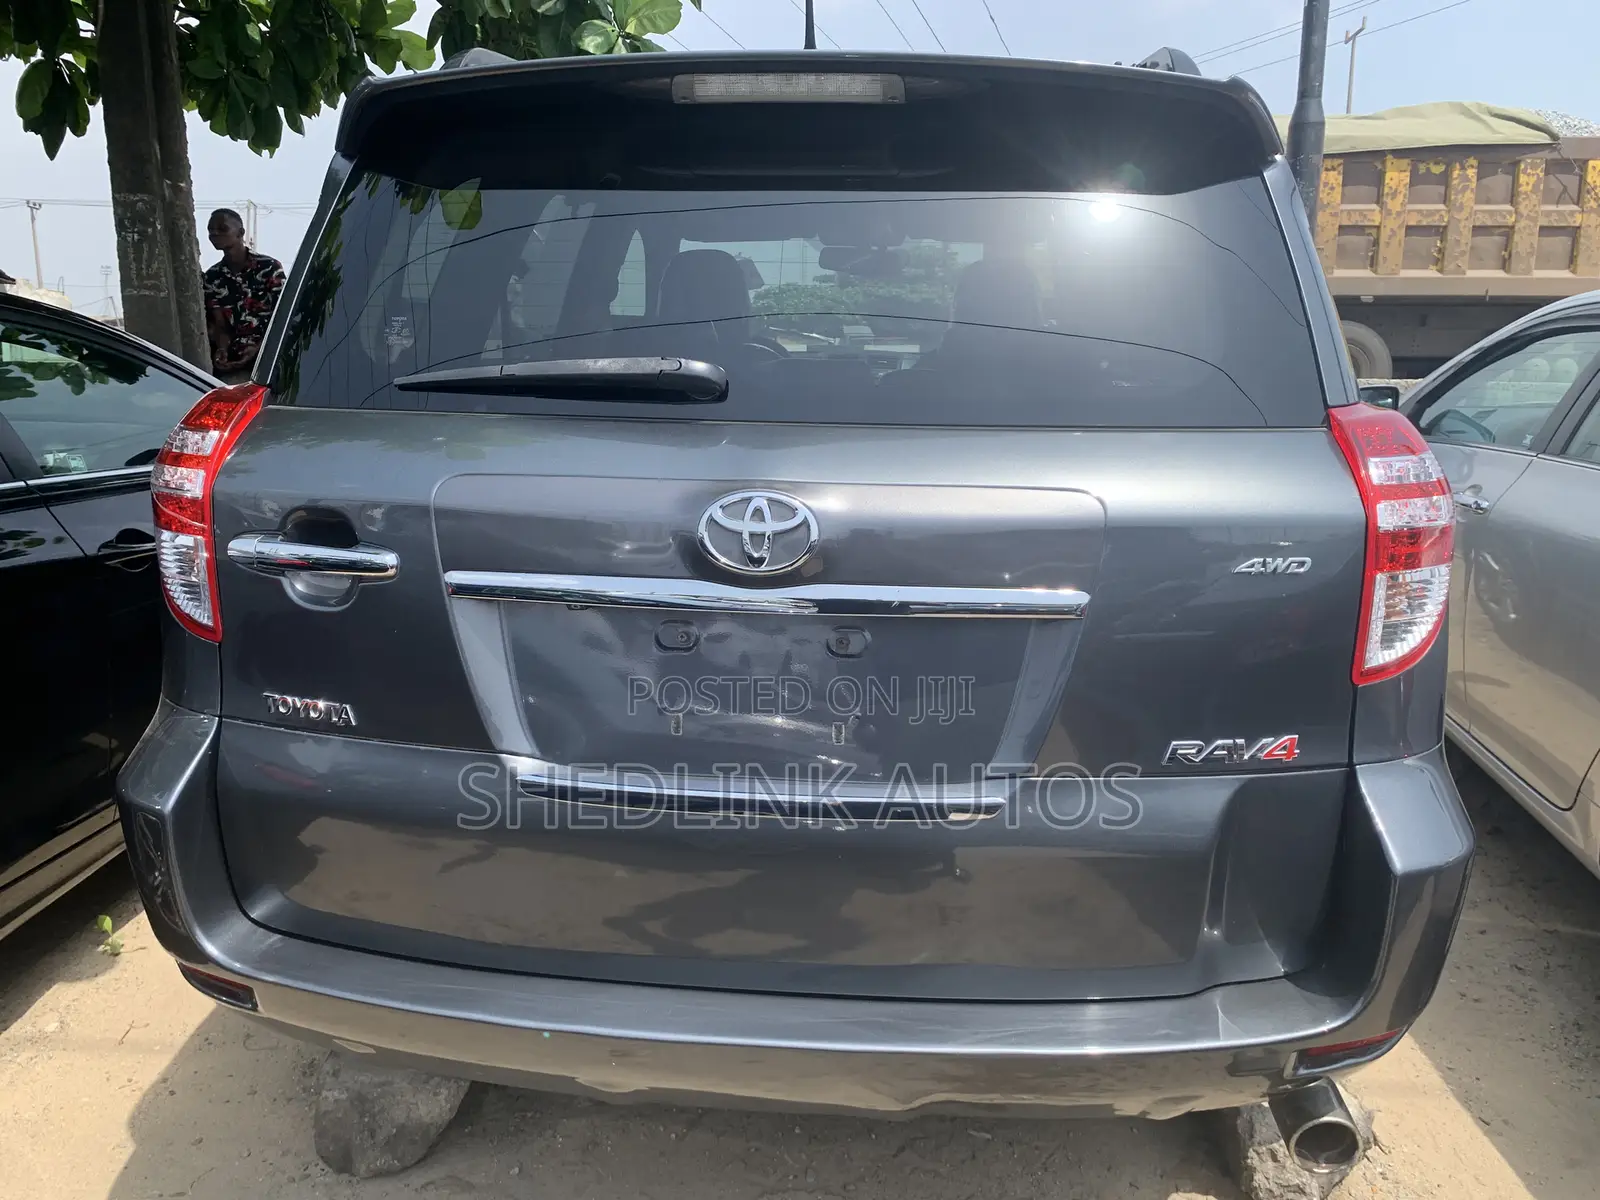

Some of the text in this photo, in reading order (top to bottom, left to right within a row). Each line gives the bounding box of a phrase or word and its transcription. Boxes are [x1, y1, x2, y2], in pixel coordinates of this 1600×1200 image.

[1231, 556, 1312, 575] 4WD
[262, 691, 358, 726] TOYOTA
[1161, 734, 1300, 765] RAV4
